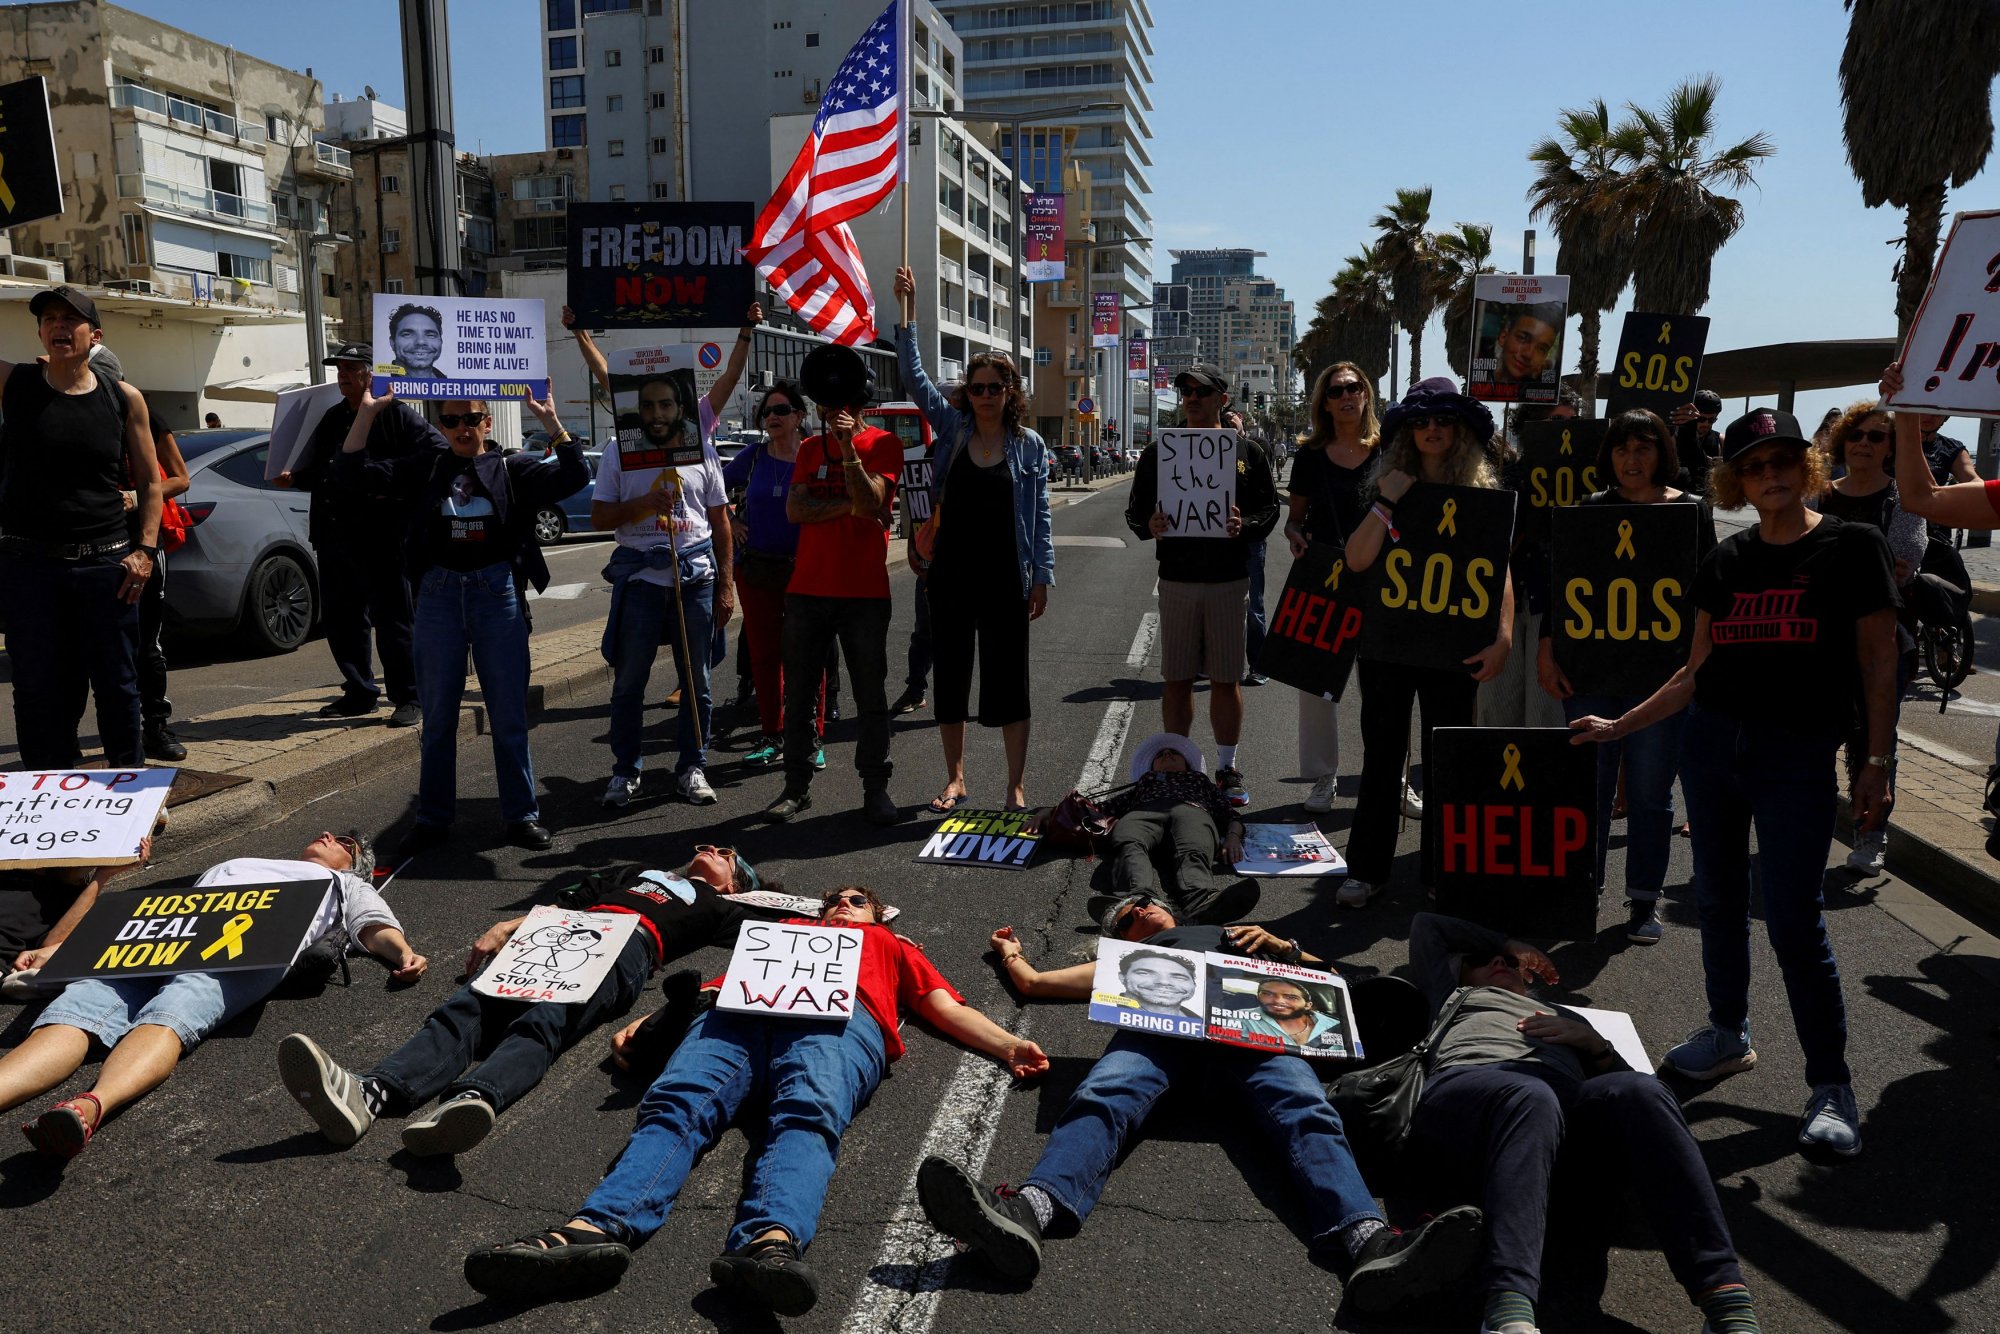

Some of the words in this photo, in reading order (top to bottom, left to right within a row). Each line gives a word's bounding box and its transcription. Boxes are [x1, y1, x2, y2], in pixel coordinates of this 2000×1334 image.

[582, 221, 742, 268] FREEDOM
[1035, 233, 1054, 241] 17.4
[615, 275, 707, 305] NOW
[457, 310, 471, 323] HE
[475, 311, 497, 323] HAS
[500, 311, 515, 323] NO
[457, 326, 484, 339] TIME
[487, 326, 501, 339] TO
[503, 327, 534, 339] WAIT.
[457, 341, 491, 354] BRING
[494, 342, 516, 354] HIM
[457, 357, 490, 370] HOME
[493, 358, 529, 370] ALIVE!
[1472, 358, 1497, 370] BRING
[1619, 351, 1693, 393] S.O.S
[1472, 370, 1488, 382] HIM
[393, 382, 429, 395] BRING
[431, 382, 462, 396] OFER
[464, 383, 497, 396] HOME
[500, 384, 528, 396] NOW
[618, 428, 642, 442] BRING
[620, 440, 636, 453] HIM
[1161, 432, 1233, 470] STOP
[1171, 464, 1220, 491] the
[1158, 490, 1231, 533] WAR!
[1380, 548, 1494, 619] S.O.S
[1273, 587, 1362, 654] HELP
[1564, 577, 1683, 642] S.O.S
[0, 792, 134, 815] rificing
[952, 810, 987, 818] ALL
[5, 812, 43, 825] the
[0, 829, 101, 851] tages
[918, 833, 1036, 865] NOW!
[1442, 803, 1588, 877] HELP
[132, 888, 280, 917] HOSTAGE
[114, 916, 199, 941] DEAL
[93, 940, 192, 970] NOW
[745, 926, 858, 961] STOP
[492, 972, 538, 987] STOP
[753, 958, 843, 983] THE
[1223, 959, 1259, 970] MATAN
[1264, 965, 1327, 982] ZANGAUKER
[739, 980, 849, 1012] WAR
[1119, 1012, 1174, 1032] BRING
[1178, 1019, 1202, 1035] OF
[1210, 1006, 1262, 1021] BRING
[1210, 1016, 1243, 1029] HIM
[1208, 1025, 1242, 1040] HOME
[1248, 1030, 1285, 1046] NOW!
